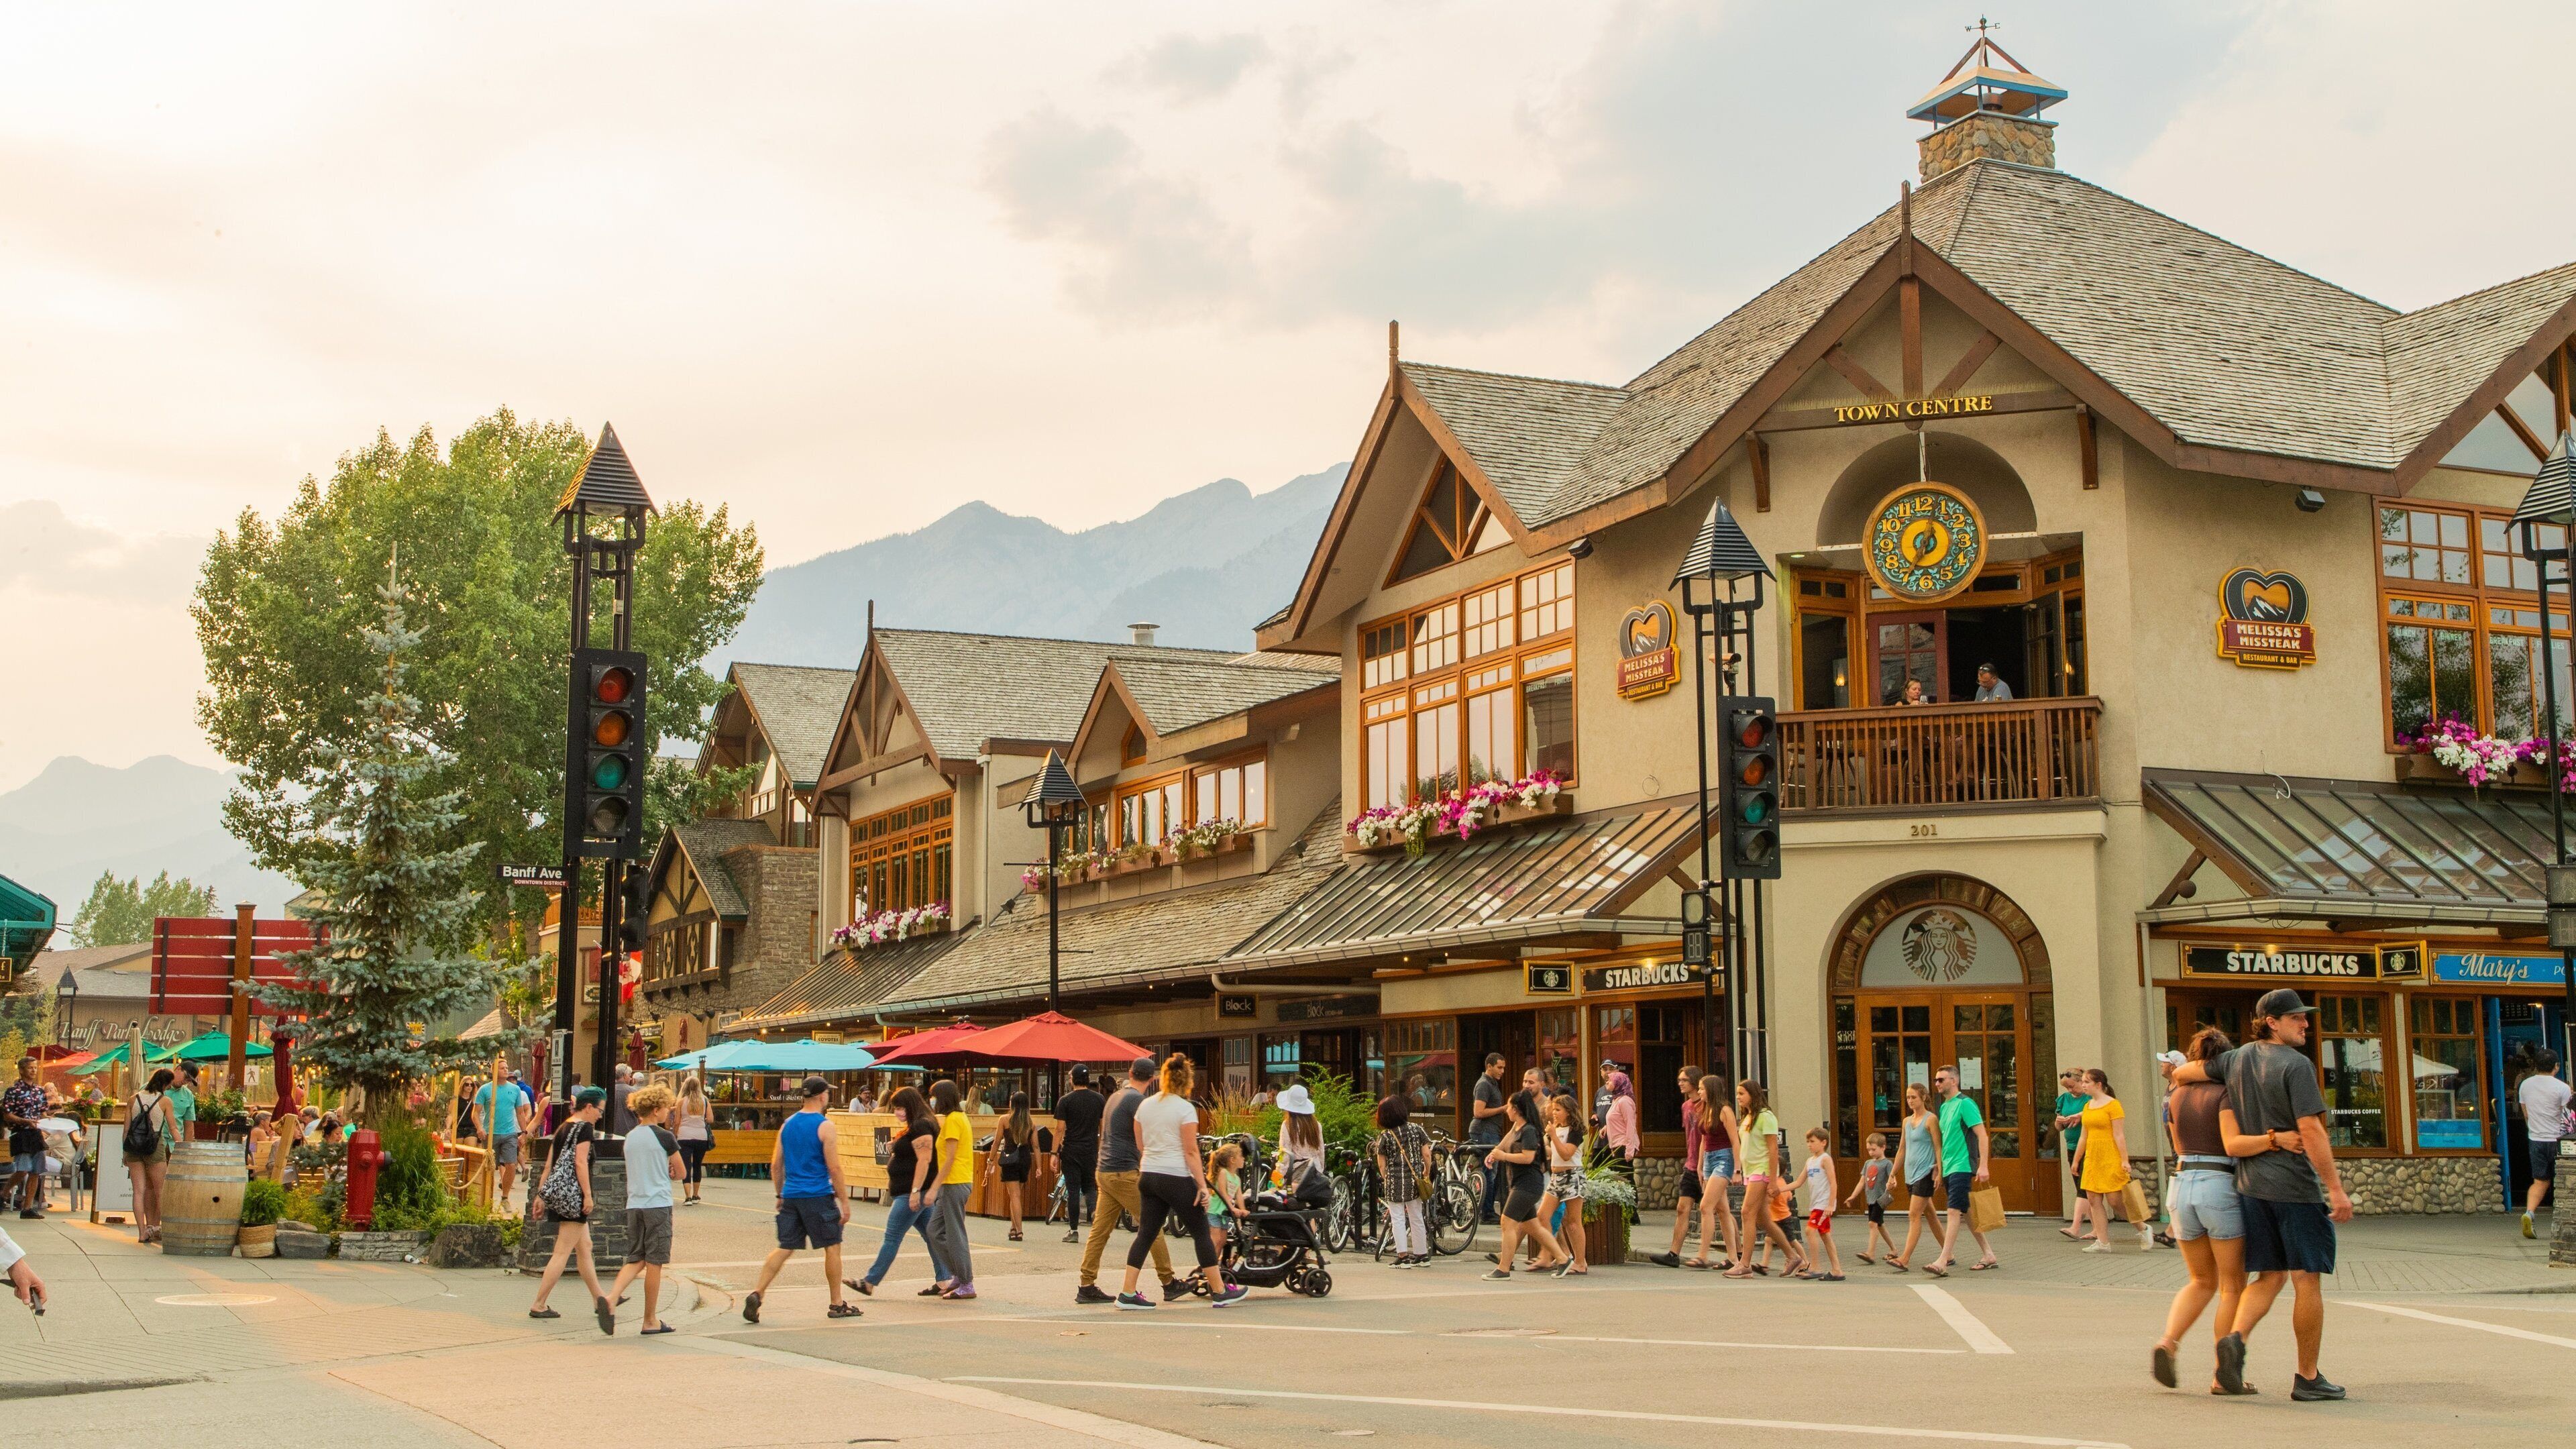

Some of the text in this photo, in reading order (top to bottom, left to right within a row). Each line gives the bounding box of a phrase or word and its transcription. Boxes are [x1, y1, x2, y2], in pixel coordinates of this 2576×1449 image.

[1835, 396, 1992, 422] TOWN CENTRE
[1898, 502, 1912, 517] 11
[1915, 496, 1933, 511] 12
[1940, 500, 1947, 515] 1
[1881, 518, 1901, 533] 10
[1952, 514, 1966, 528] 2
[1880, 538, 1894, 553] 9
[1957, 533, 1972, 547] 3
[1885, 554, 1899, 569] 8
[1957, 550, 1966, 566] 4
[1899, 568, 1911, 582] 7
[1940, 566, 1953, 580] 5
[1919, 575, 1933, 589] 6
[2237, 624, 2302, 638] MELISSA'S
[2239, 636, 2300, 649] MISSTEAK
[2536, 641, 2565, 650] FLIES
[1624, 653, 1665, 673] MELISSA'S
[2243, 653, 2278, 663] RESTAURANT
[1625, 665, 1664, 683] MISSTEAK
[1629, 685, 1650, 696] RESTAURANT
[1911, 824, 1937, 836] 201
[503, 865, 562, 879] Banff Ave
[2226, 951, 2359, 975] STARBUCKS
[2459, 953, 2530, 985] Mary's
[1605, 963, 1688, 988] STARBUCKS
[1226, 999, 1251, 1011] Block
[1307, 1001, 1325, 1018] Block
[60, 1018, 103, 1050] Banff
[141, 1016, 186, 1048] Lodge
